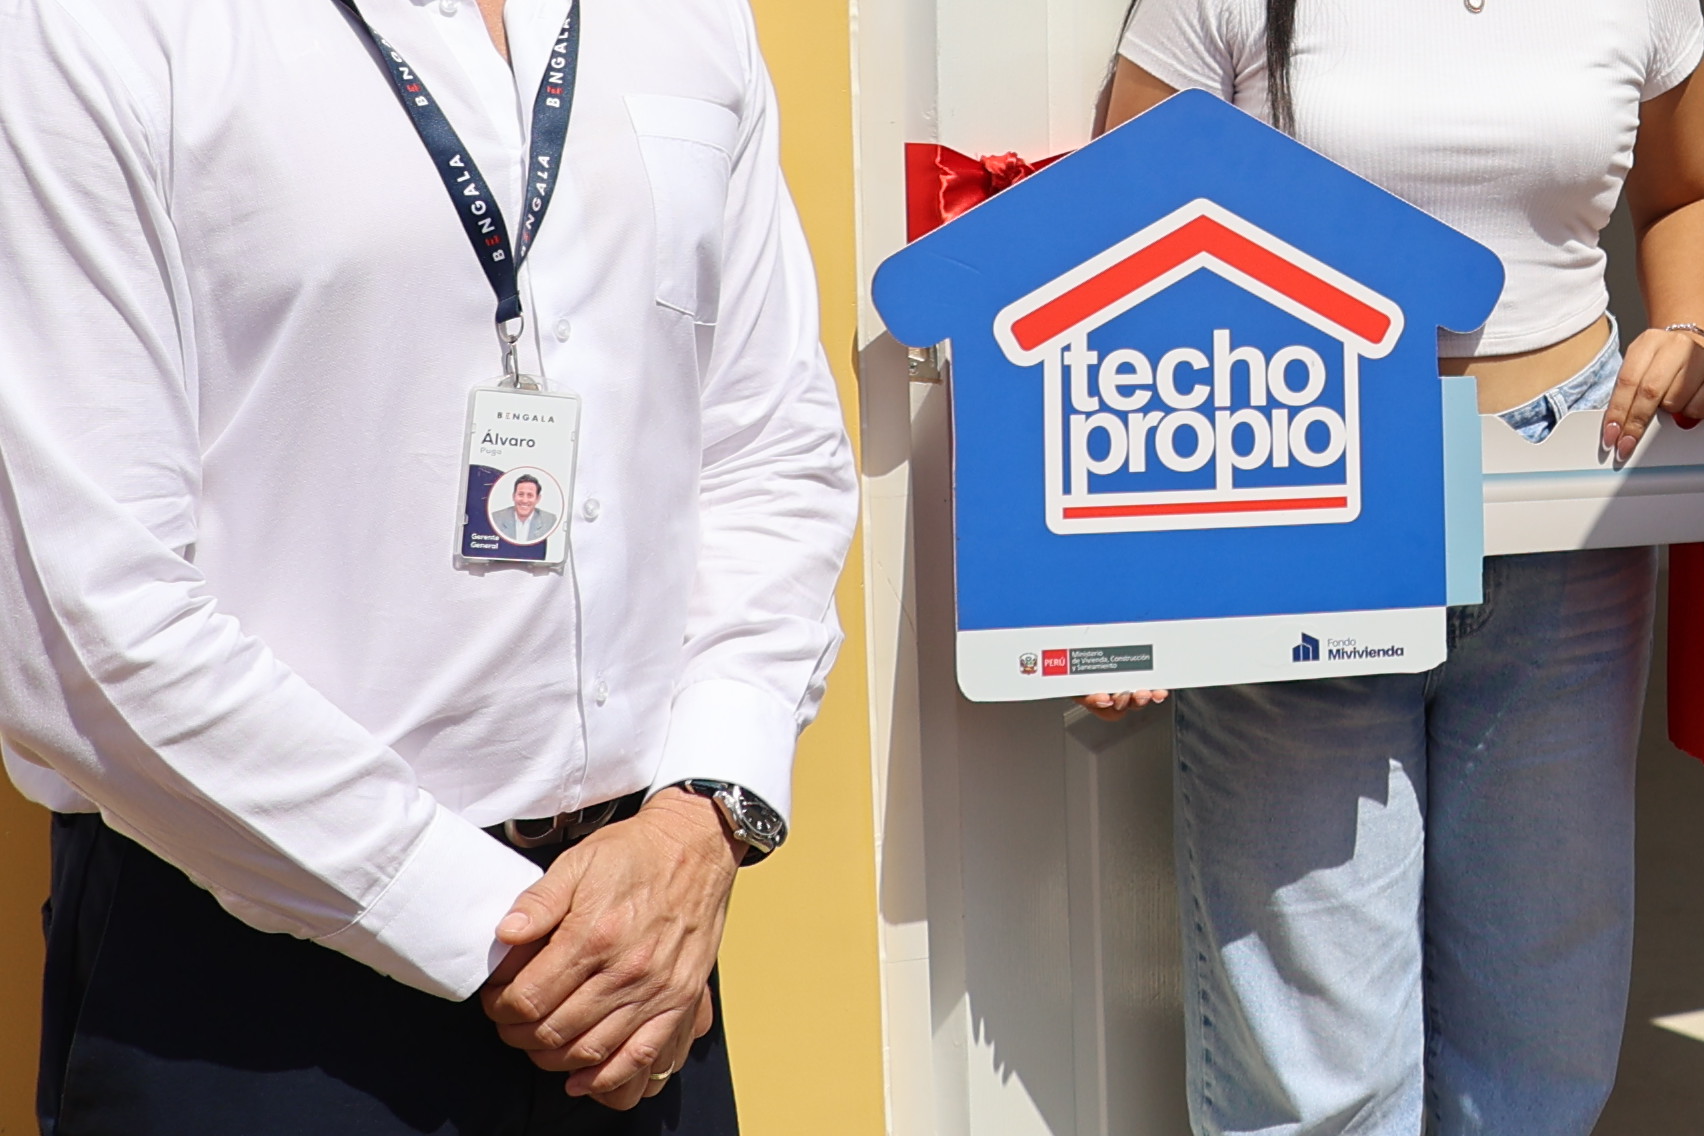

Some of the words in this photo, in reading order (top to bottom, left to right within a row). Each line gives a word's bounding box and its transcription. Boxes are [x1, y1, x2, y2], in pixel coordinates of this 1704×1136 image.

[448, 154, 506, 262] BENGALA
[1064, 329, 1327, 412] techo
[496, 411, 555, 424] BENGALA
[481, 428, 536, 448] Álvaro
[1069, 406, 1347, 495] propio
[1327, 637, 1357, 648] Fondo
[1071, 650, 1104, 658] Ministerio
[1071, 657, 1081, 665] de
[1110, 654, 1151, 663] Construcción
[1327, 645, 1405, 662] Mivivienda
[1044, 656, 1066, 667] PERÚ
[1071, 665, 1076, 673] y
[1077, 663, 1118, 672] Saneamiento
